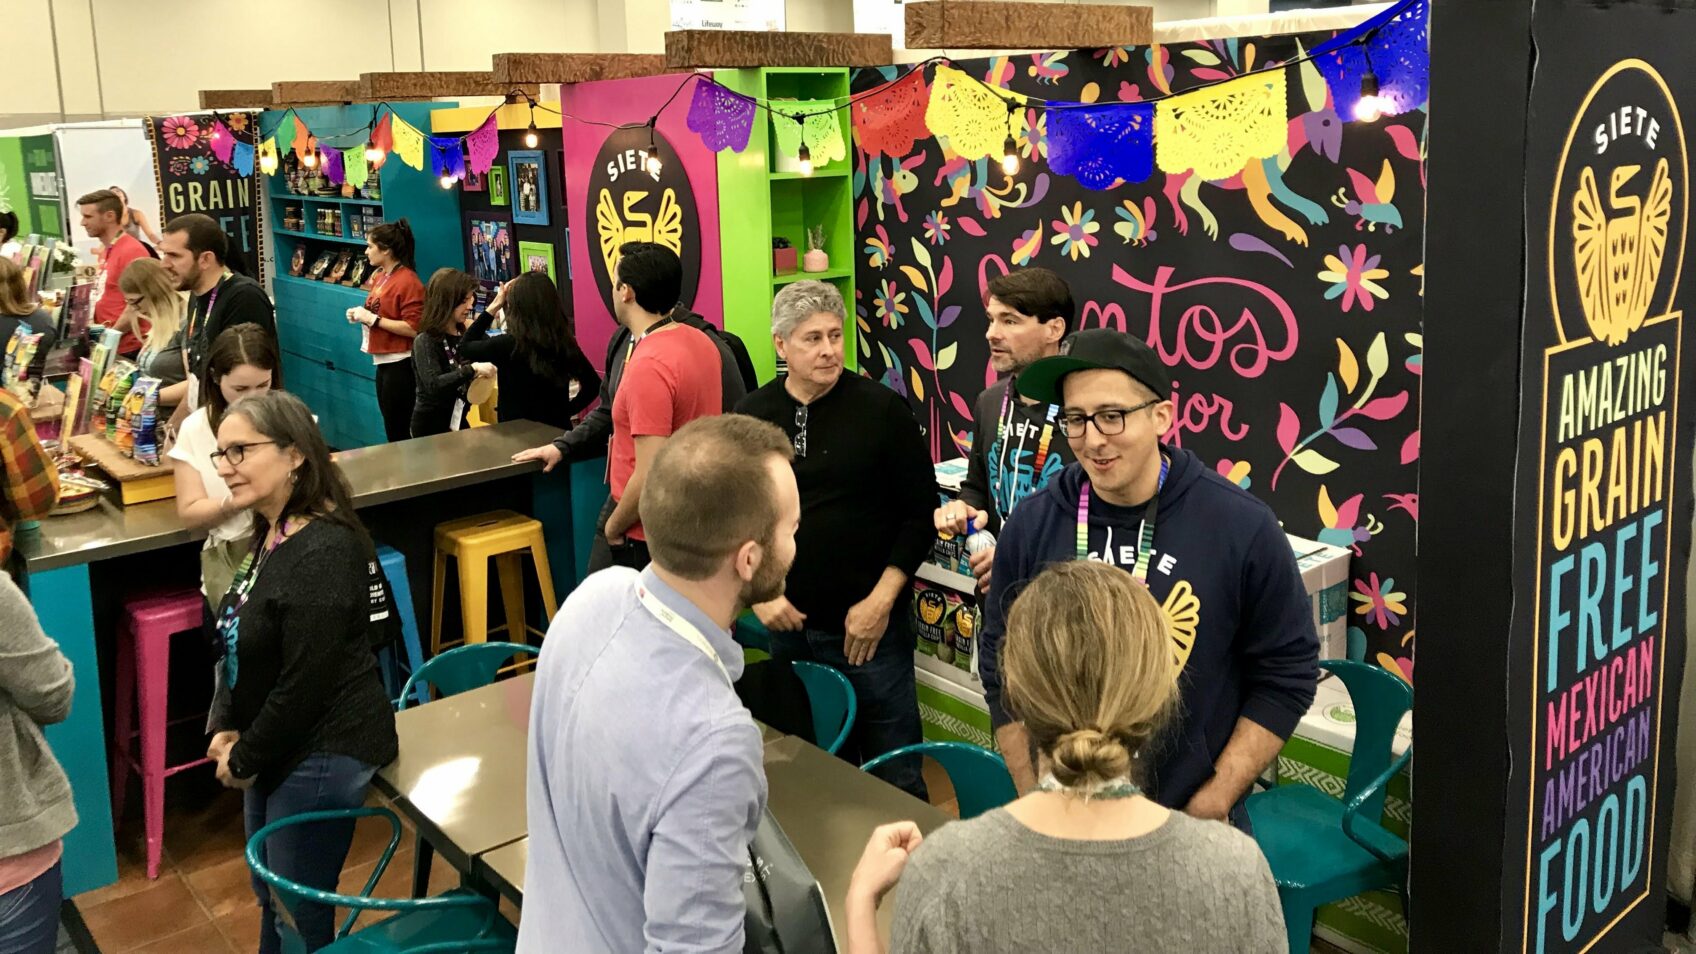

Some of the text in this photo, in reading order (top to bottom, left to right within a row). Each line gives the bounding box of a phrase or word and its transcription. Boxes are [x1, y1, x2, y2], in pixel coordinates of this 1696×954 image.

[701, 19, 723, 29] Lifeway
[168, 178, 250, 213] GRAIN
[1594, 105, 1660, 155] SIETE
[1558, 343, 1667, 443] AMAZING
[1552, 410, 1666, 551] GRAIN
[1547, 508, 1663, 693] FREE
[1545, 636, 1655, 771] MEXICAN
[1541, 706, 1651, 842] AMERICAN
[1536, 774, 1647, 954] FOOD
